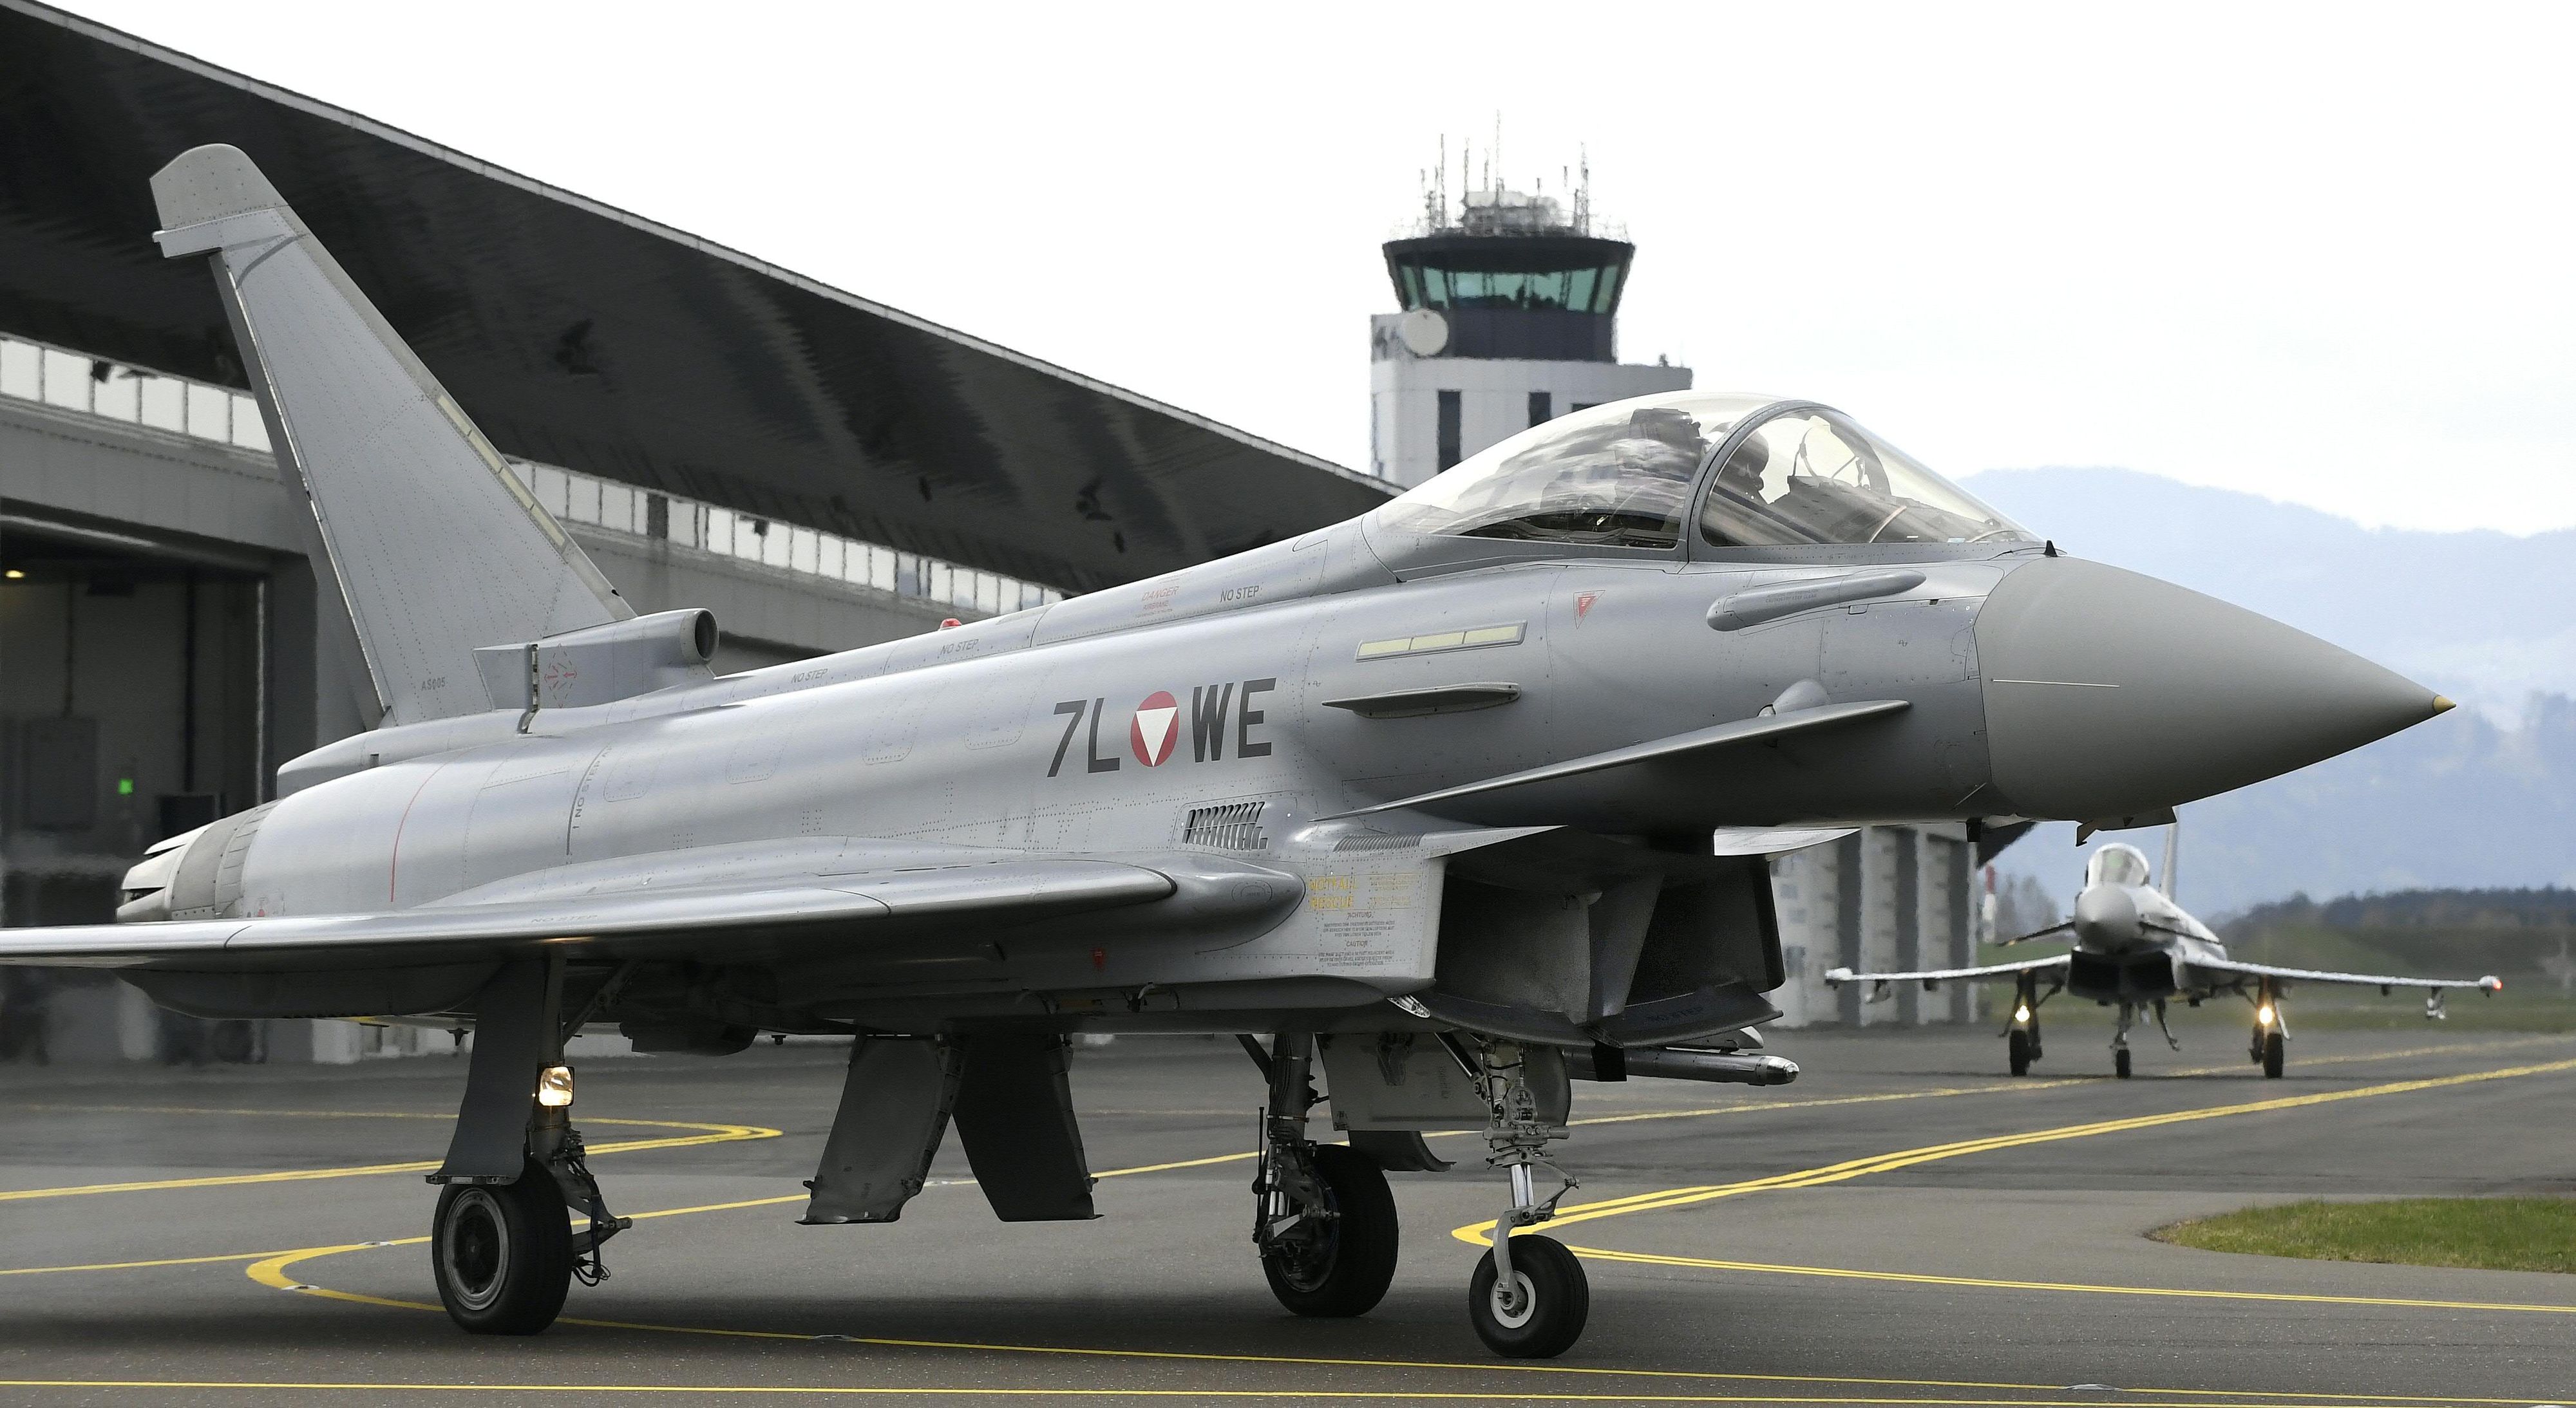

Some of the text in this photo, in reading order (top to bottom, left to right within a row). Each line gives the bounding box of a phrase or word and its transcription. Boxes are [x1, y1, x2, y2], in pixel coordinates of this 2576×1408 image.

[1142, 586, 1180, 601] DANGER
[1220, 585, 1260, 603] NO STEP
[940, 639, 980, 655] NO STEP
[791, 668, 828, 683] NO STEP
[1191, 677, 1277, 764] WE
[1309, 896, 1354, 910] RESCUE
